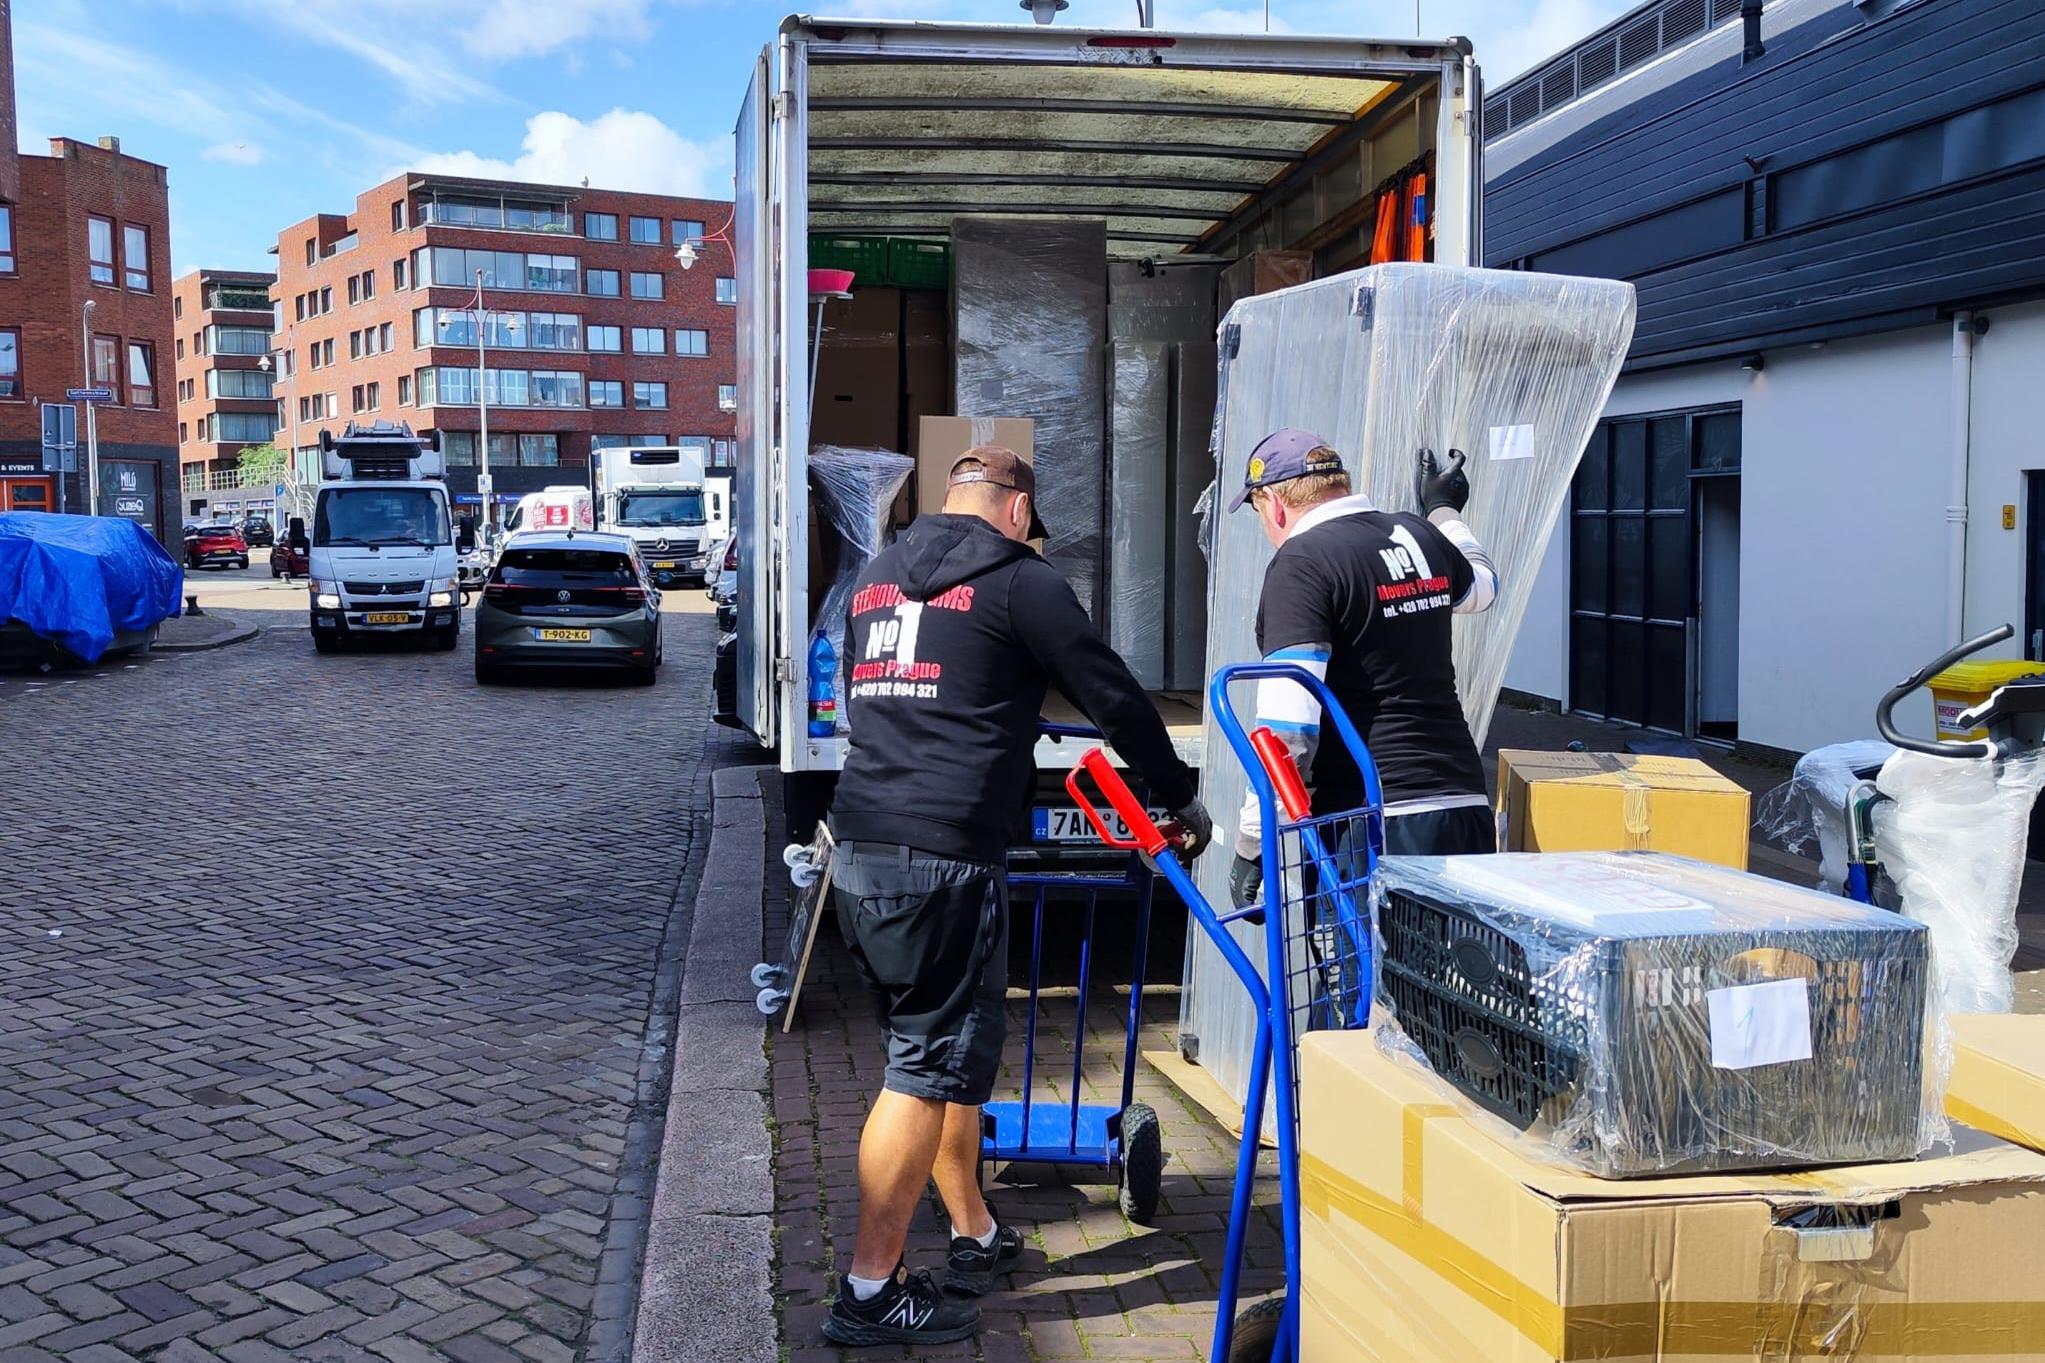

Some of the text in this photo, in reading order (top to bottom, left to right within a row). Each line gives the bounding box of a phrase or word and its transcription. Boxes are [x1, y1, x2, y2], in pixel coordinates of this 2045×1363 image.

[1377, 584, 1417, 602] Movers
[543, 630, 588, 640] T-902-KG
[885, 659, 941, 681] Prague
[893, 682, 916, 698] 994
[916, 683, 938, 699] 321
[1035, 827, 1047, 836] CZ
